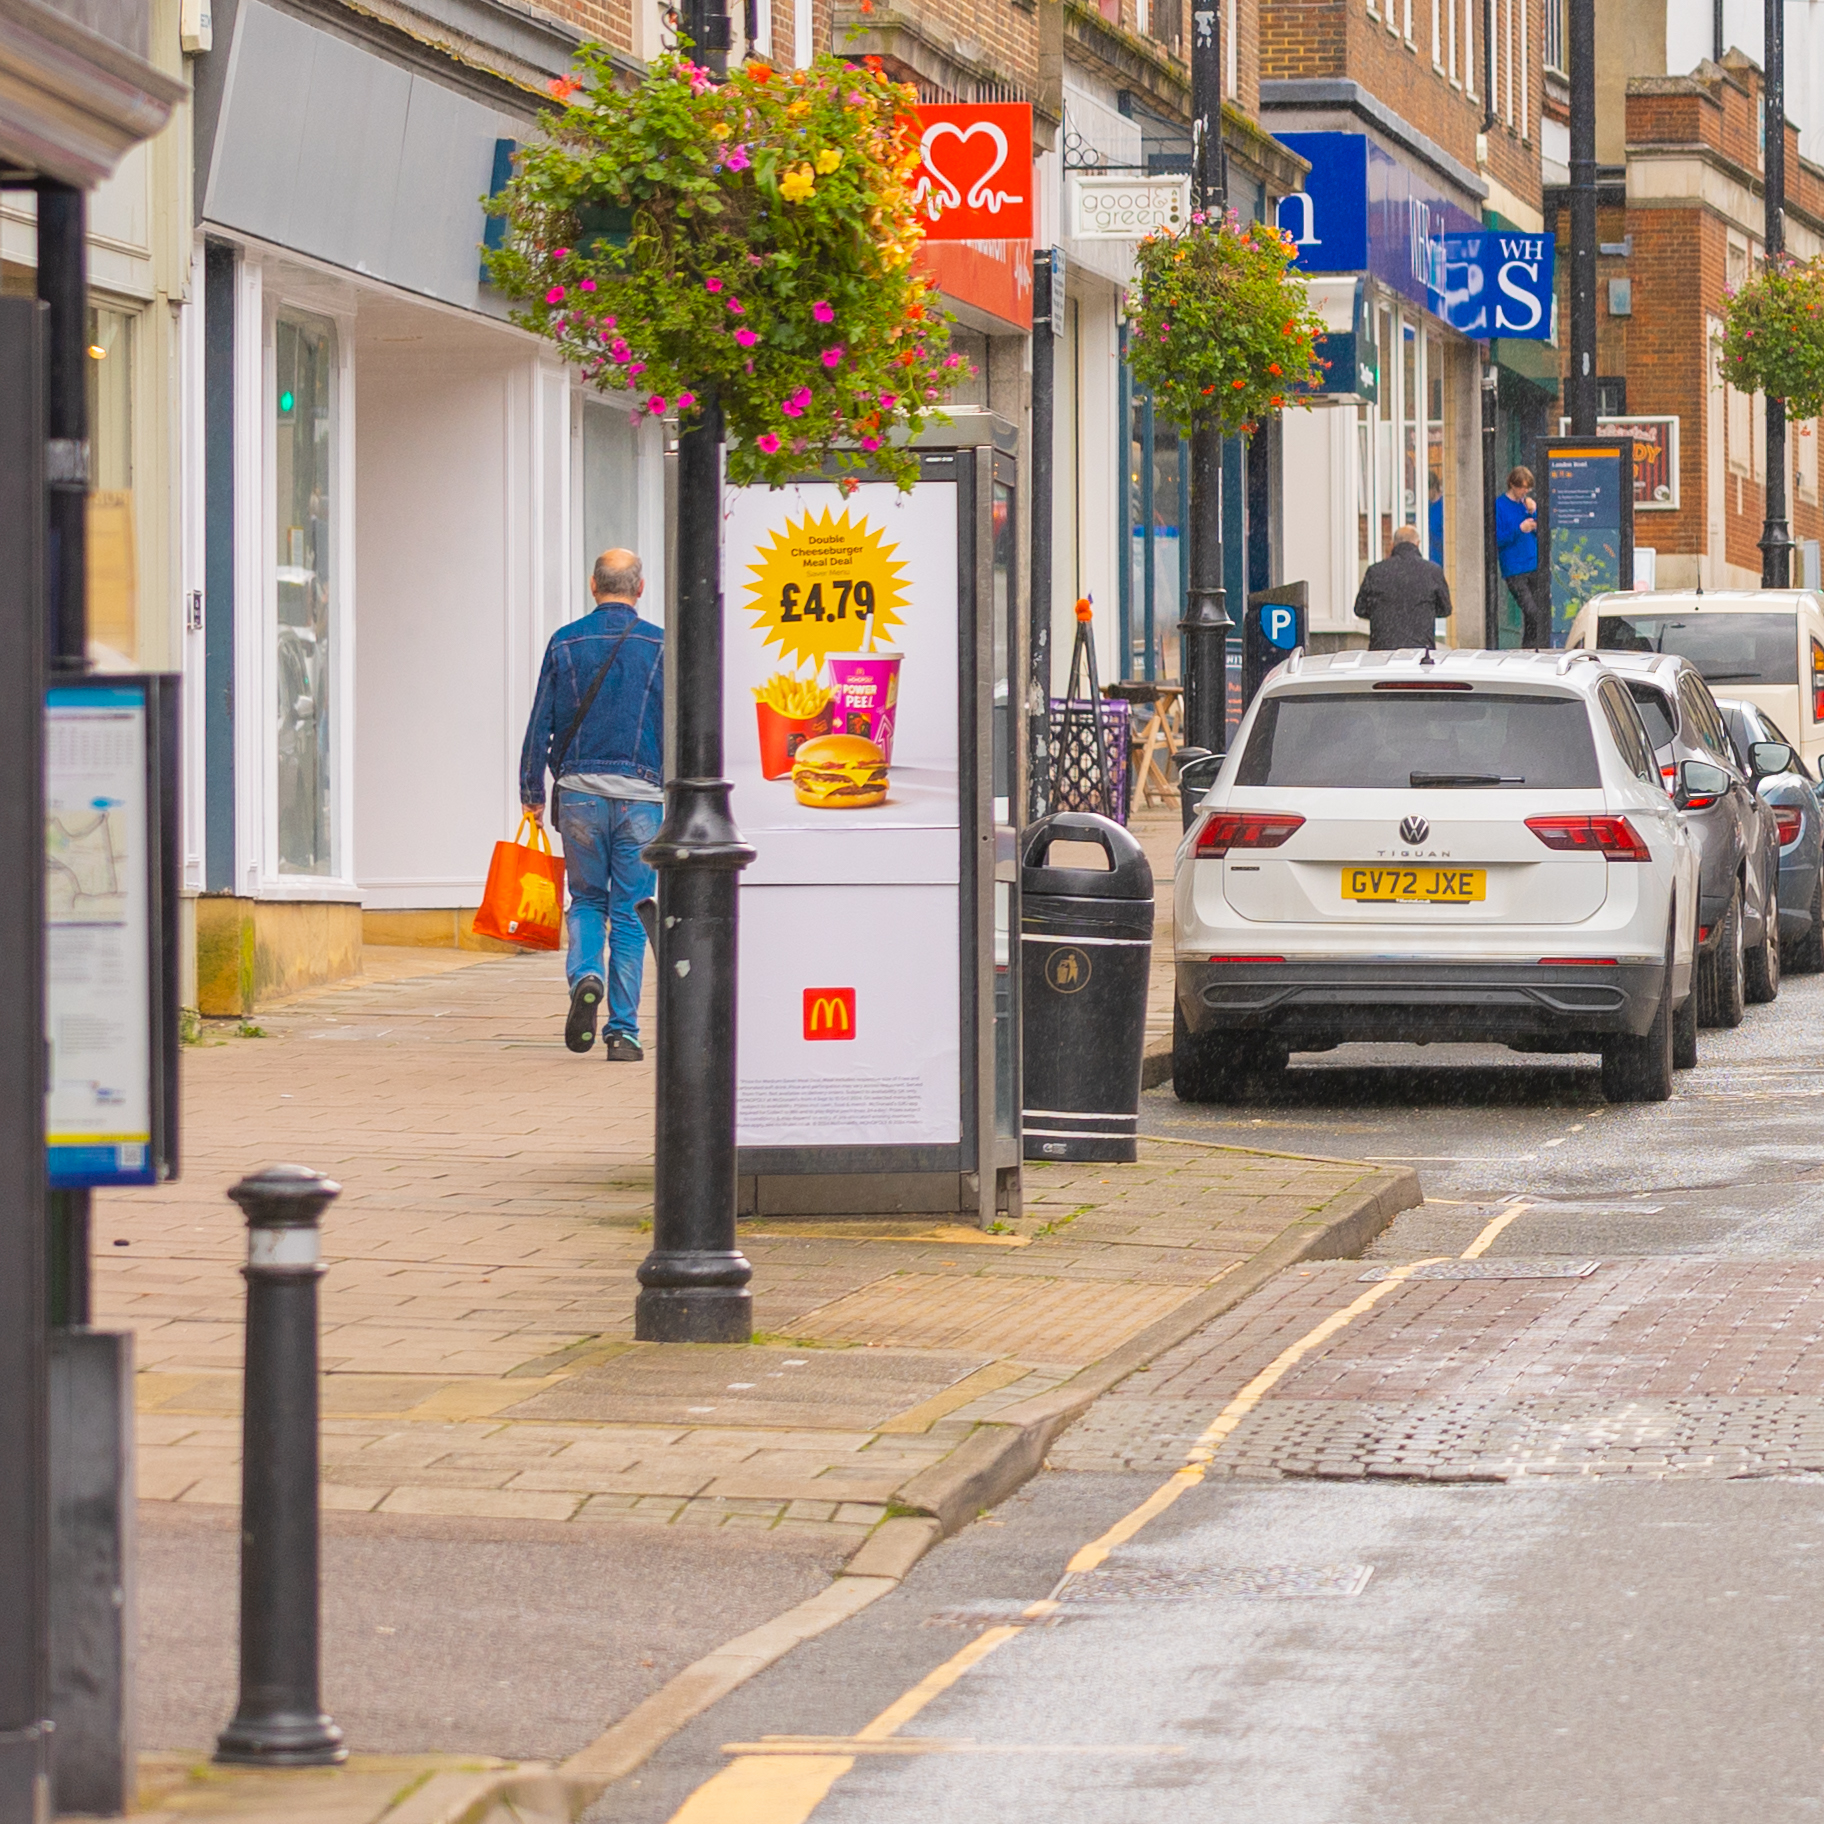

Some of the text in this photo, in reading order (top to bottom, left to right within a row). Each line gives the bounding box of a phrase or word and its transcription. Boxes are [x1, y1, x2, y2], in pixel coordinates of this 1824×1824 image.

[1095, 210, 1165, 229] green
[1499, 239, 1544, 259] WH
[1495, 261, 1543, 331] S
[808, 535, 846, 545] Double
[791, 546, 864, 558] Cheeseburger
[803, 557, 853, 568] Meal Deal
[780, 580, 876, 622] £4.79
[843, 684, 878, 695] POWER
[845, 695, 875, 709] PEEL
[1351, 871, 1474, 896] GV72 JXE
